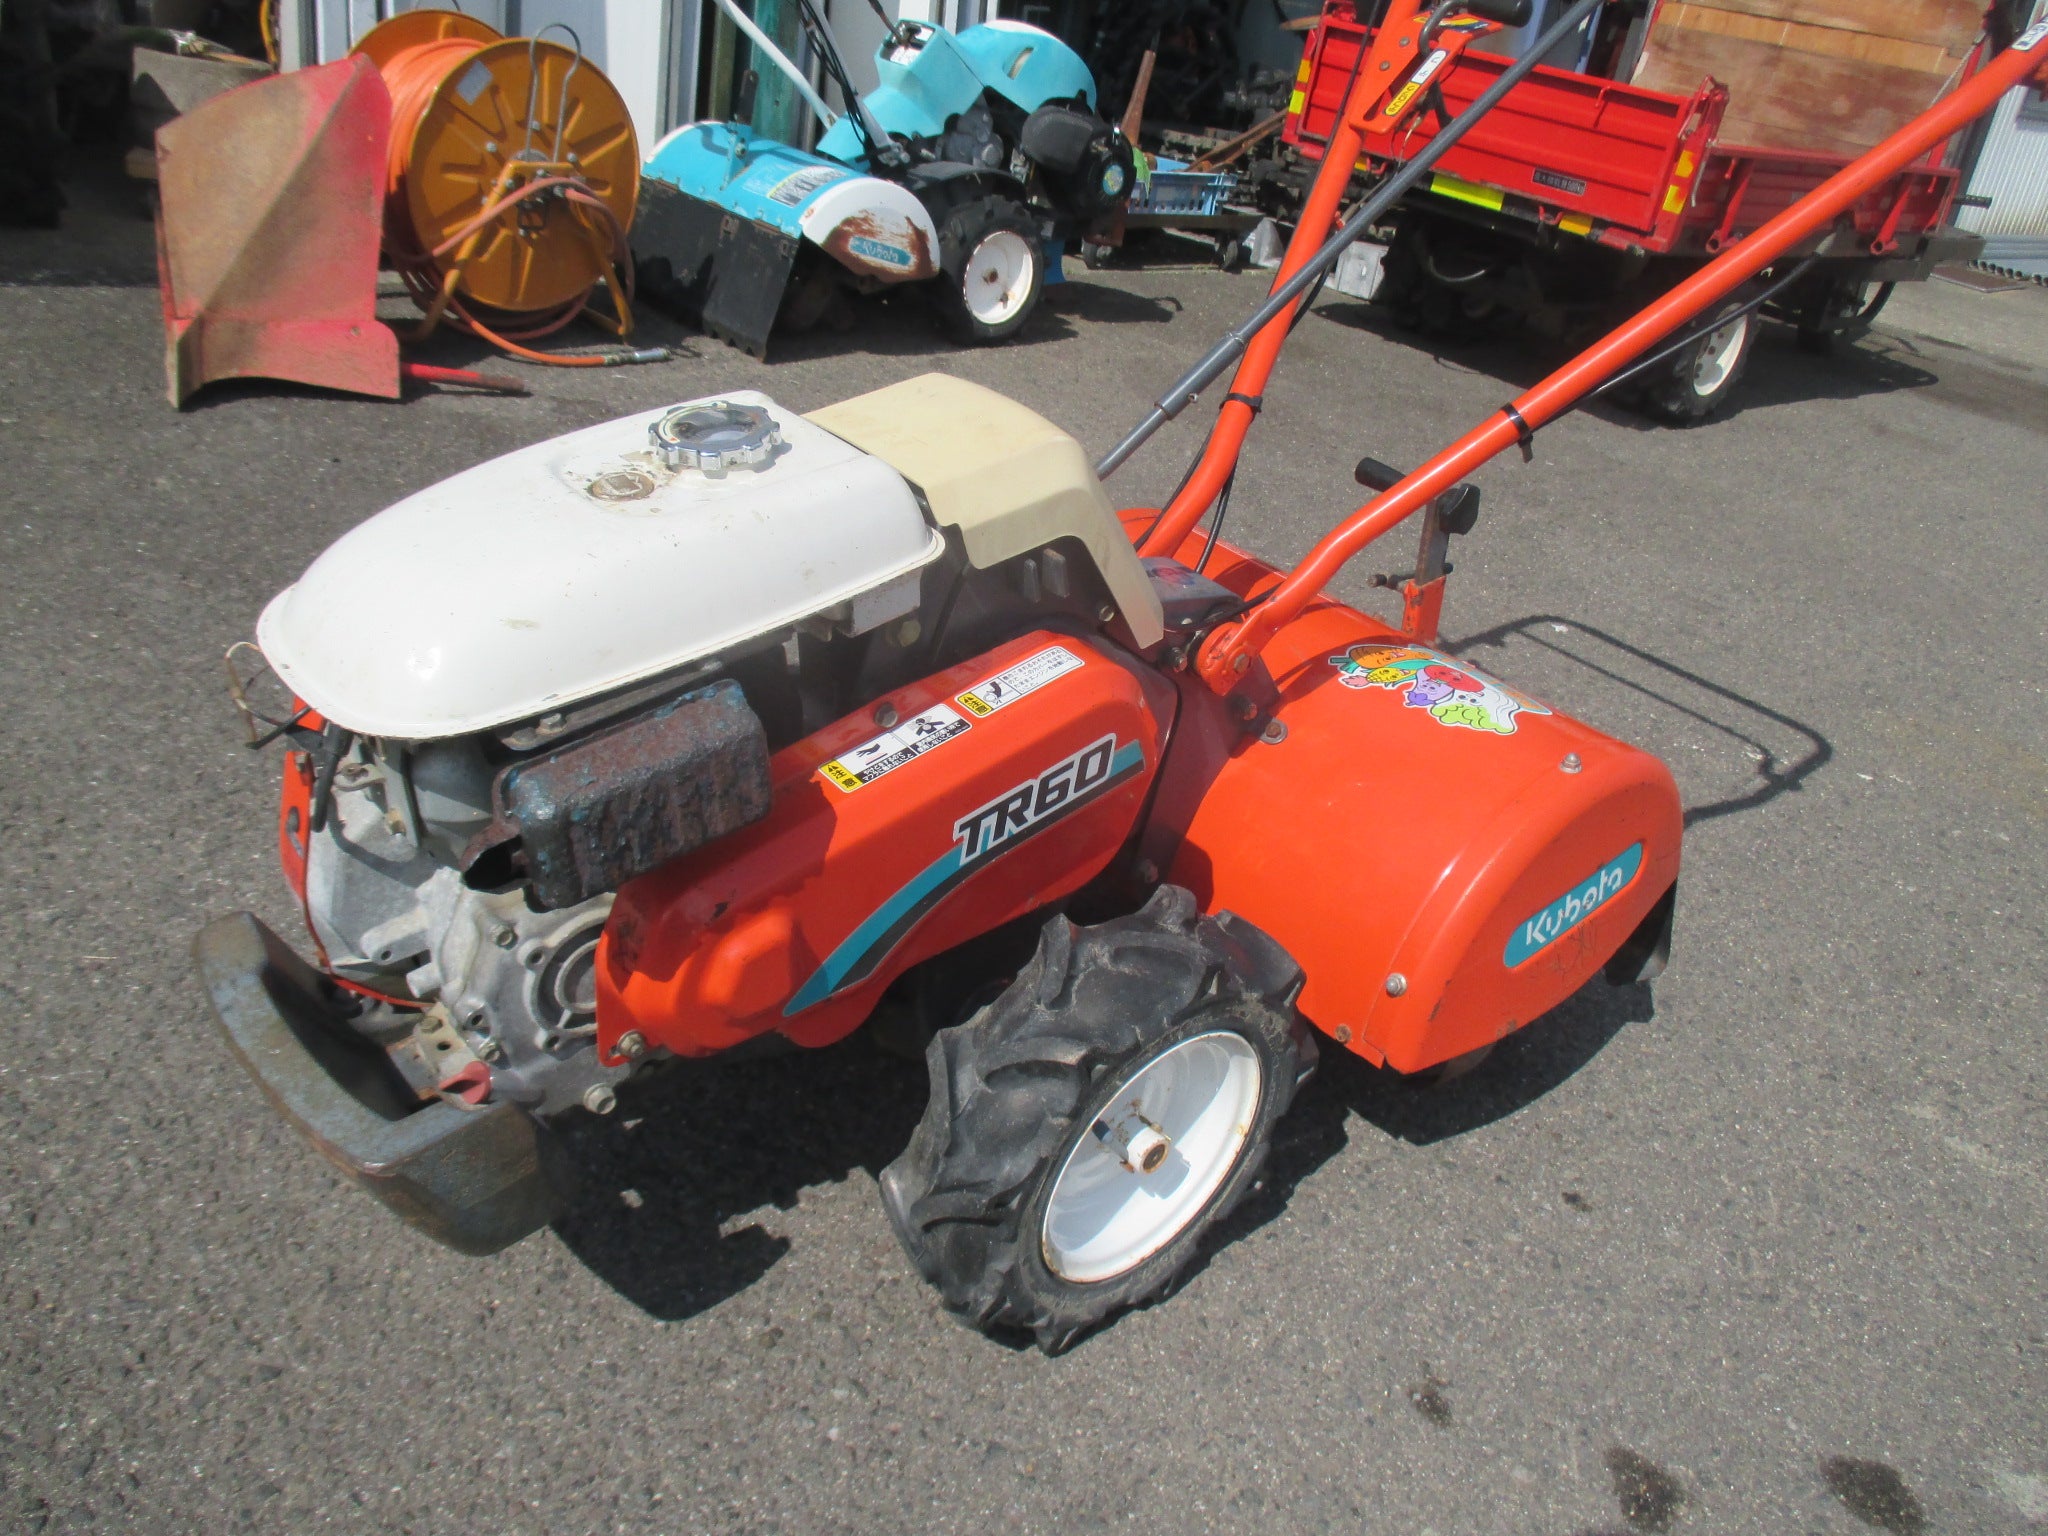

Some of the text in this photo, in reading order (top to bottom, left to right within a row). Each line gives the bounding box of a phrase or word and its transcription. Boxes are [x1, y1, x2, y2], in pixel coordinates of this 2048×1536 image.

[831, 768, 858, 789] 注意
[956, 736, 1114, 861] TR60
[1525, 867, 1623, 945] Kubota
